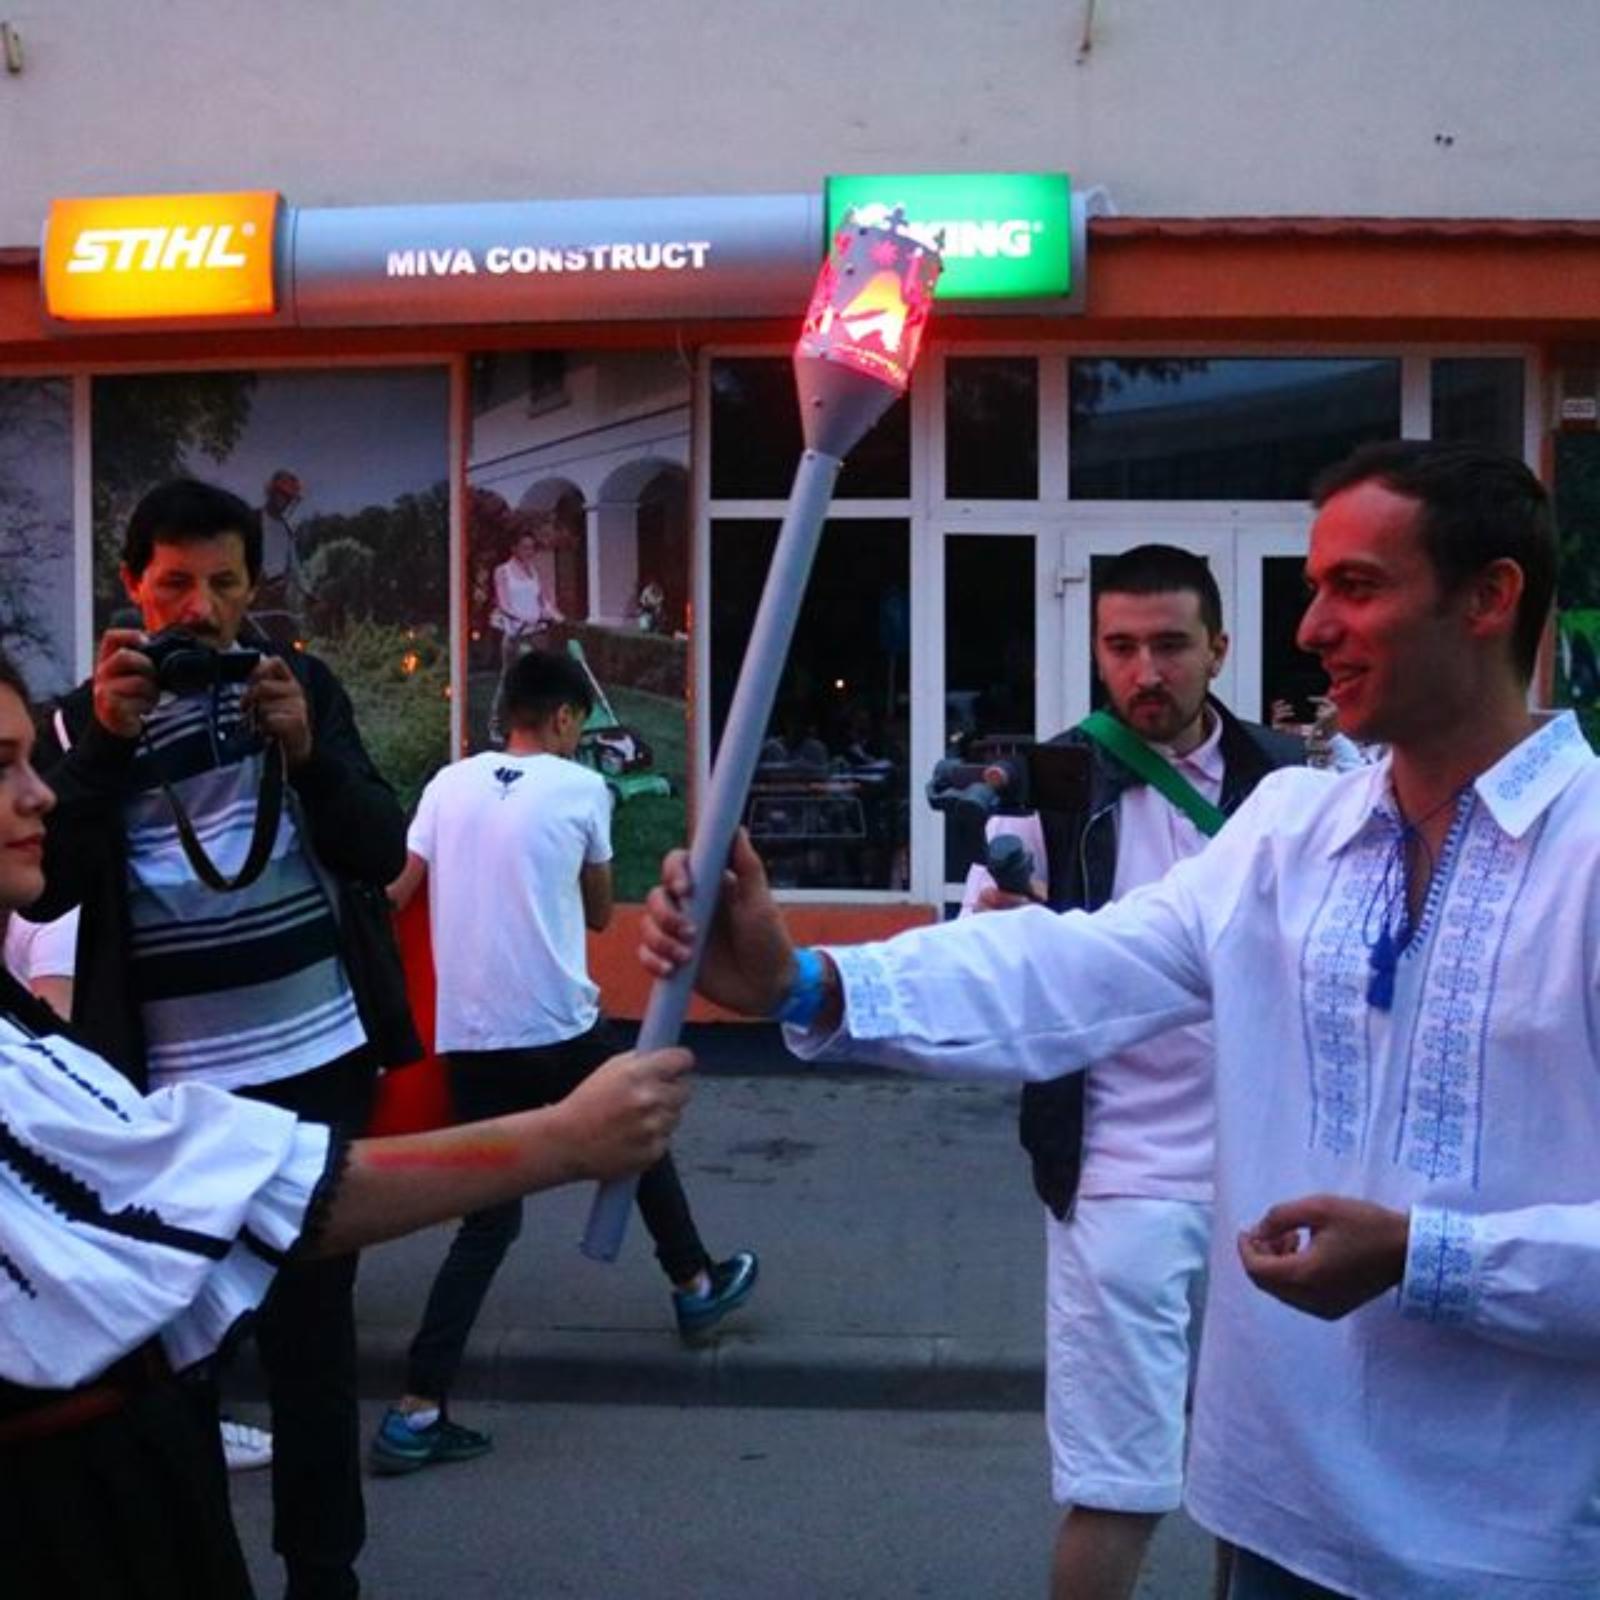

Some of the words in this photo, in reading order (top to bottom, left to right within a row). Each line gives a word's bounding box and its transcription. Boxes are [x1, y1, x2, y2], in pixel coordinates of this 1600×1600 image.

[66, 224, 247, 273] STIHL
[386, 249, 477, 276] MIVA
[485, 241, 710, 274] CONSTRUCT
